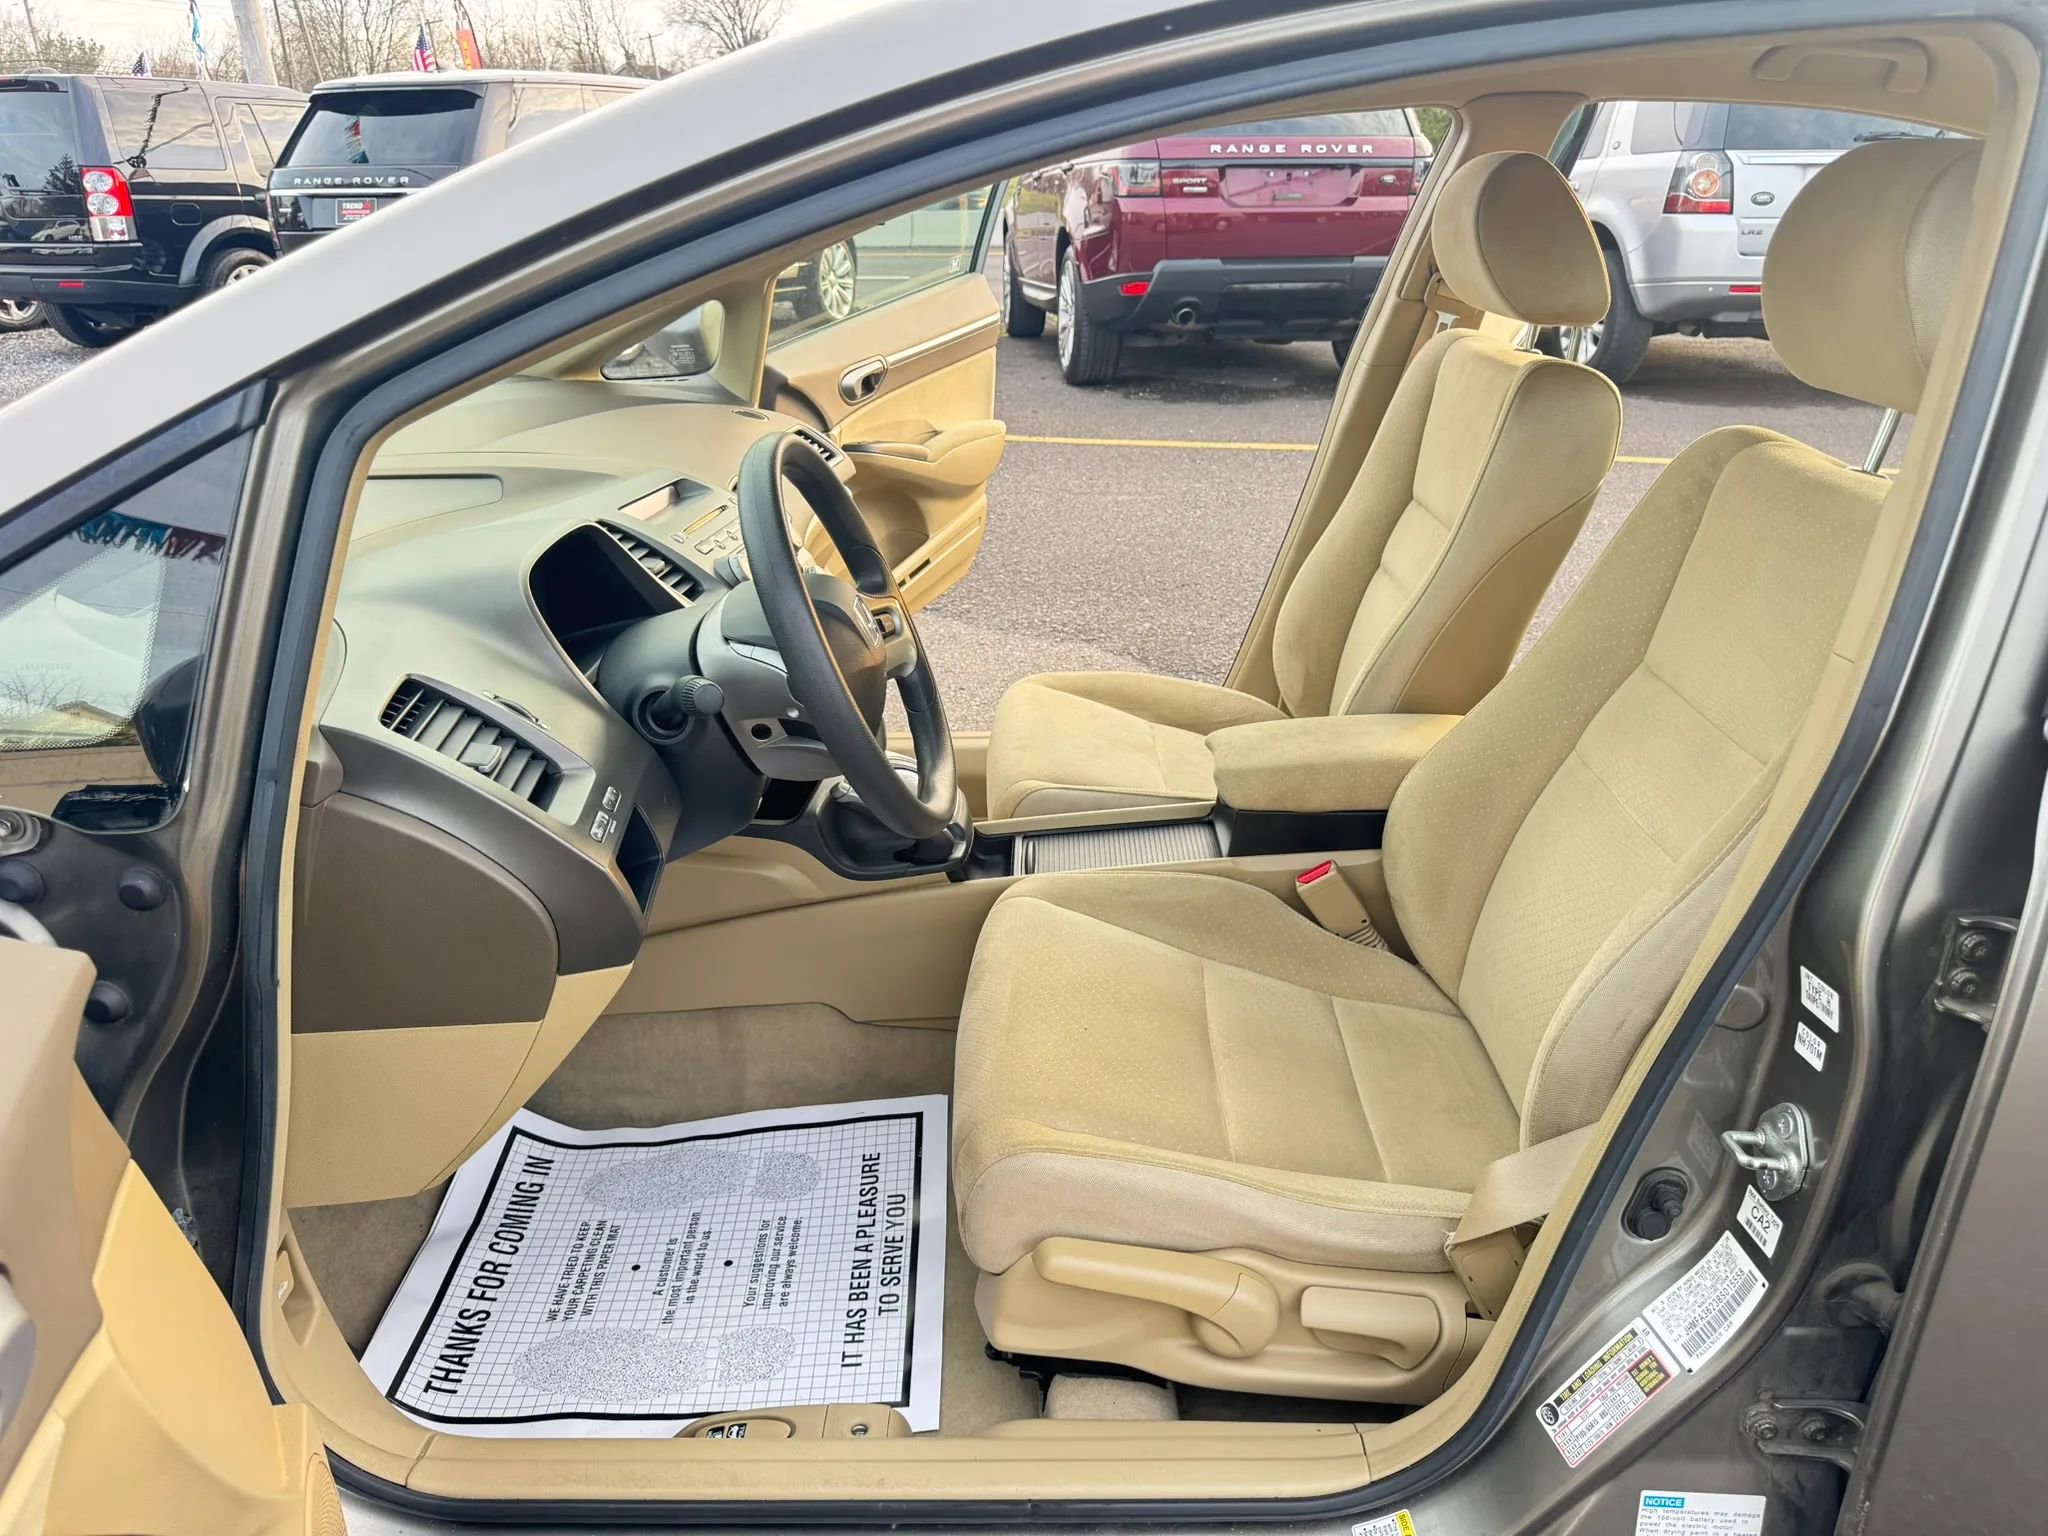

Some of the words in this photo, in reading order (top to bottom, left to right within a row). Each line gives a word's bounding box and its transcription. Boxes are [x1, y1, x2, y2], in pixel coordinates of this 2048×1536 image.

[1210, 144, 1286, 153] RANGE
[1300, 144, 1374, 153] ROVER
[294, 177, 343, 185] RANGE
[352, 176, 410, 184] ROVER
[522, 1155, 555, 1176] IN
[856, 1152, 881, 1240] PLEASURE
[488, 1181, 545, 1255] COMING
[886, 1193, 906, 1231] YOU
[1751, 1206, 1770, 1233] CA2
[576, 1221, 591, 1241] KEEP
[686, 1211, 701, 1240] person
[702, 1227, 713, 1241] us.
[758, 1220, 771, 1231] for
[774, 1216, 787, 1247] service
[787, 1216, 803, 1257] welcome.
[570, 1243, 584, 1254] TO
[696, 1242, 709, 1251] to
[750, 1232, 769, 1284] suggestions
[771, 1248, 781, 1262] our
[854, 1242, 874, 1253] A
[561, 1256, 579, 1281] TRIED
[562, 1297, 580, 1322] YOUR
[572, 1248, 598, 1295] CARPETING
[590, 1220, 608, 1246] CLEAN
[580, 1294, 598, 1317] WITH
[589, 1272, 605, 1292] THIS
[597, 1243, 615, 1270] PAPER
[607, 1224, 621, 1242] MAT
[657, 1247, 675, 1288] customer
[666, 1237, 679, 1246] is
[672, 1241, 693, 1283] important
[693, 1252, 706, 1277] world
[880, 1235, 904, 1287] SERVE
[467, 1260, 512, 1302] FOR
[780, 1259, 797, 1289] always
[849, 1258, 872, 1302] BEEN
[552, 1282, 569, 1305] HAVE
[668, 1284, 682, 1307] most
[686, 1279, 699, 1294] the
[743, 1287, 758, 1308] Your
[759, 1264, 780, 1310] improving
[682, 1295, 695, 1305] in
[779, 1291, 790, 1307] are
[878, 1293, 900, 1316] TO
[545, 1308, 560, 1322] WE
[661, 1309, 675, 1325] the
[843, 1307, 867, 1345] HAS
[423, 1309, 491, 1394] THANKS
[841, 1351, 863, 1368] IT
[1559, 1389, 1571, 1401] TIRE
[1571, 1379, 1584, 1390] AND
[1583, 1360, 1603, 1380] LOADING
[1603, 1332, 1634, 1362] INFORMATION
[1645, 1497, 1684, 1507] NOTICE
[1398, 1514, 1410, 1532] SIDE
